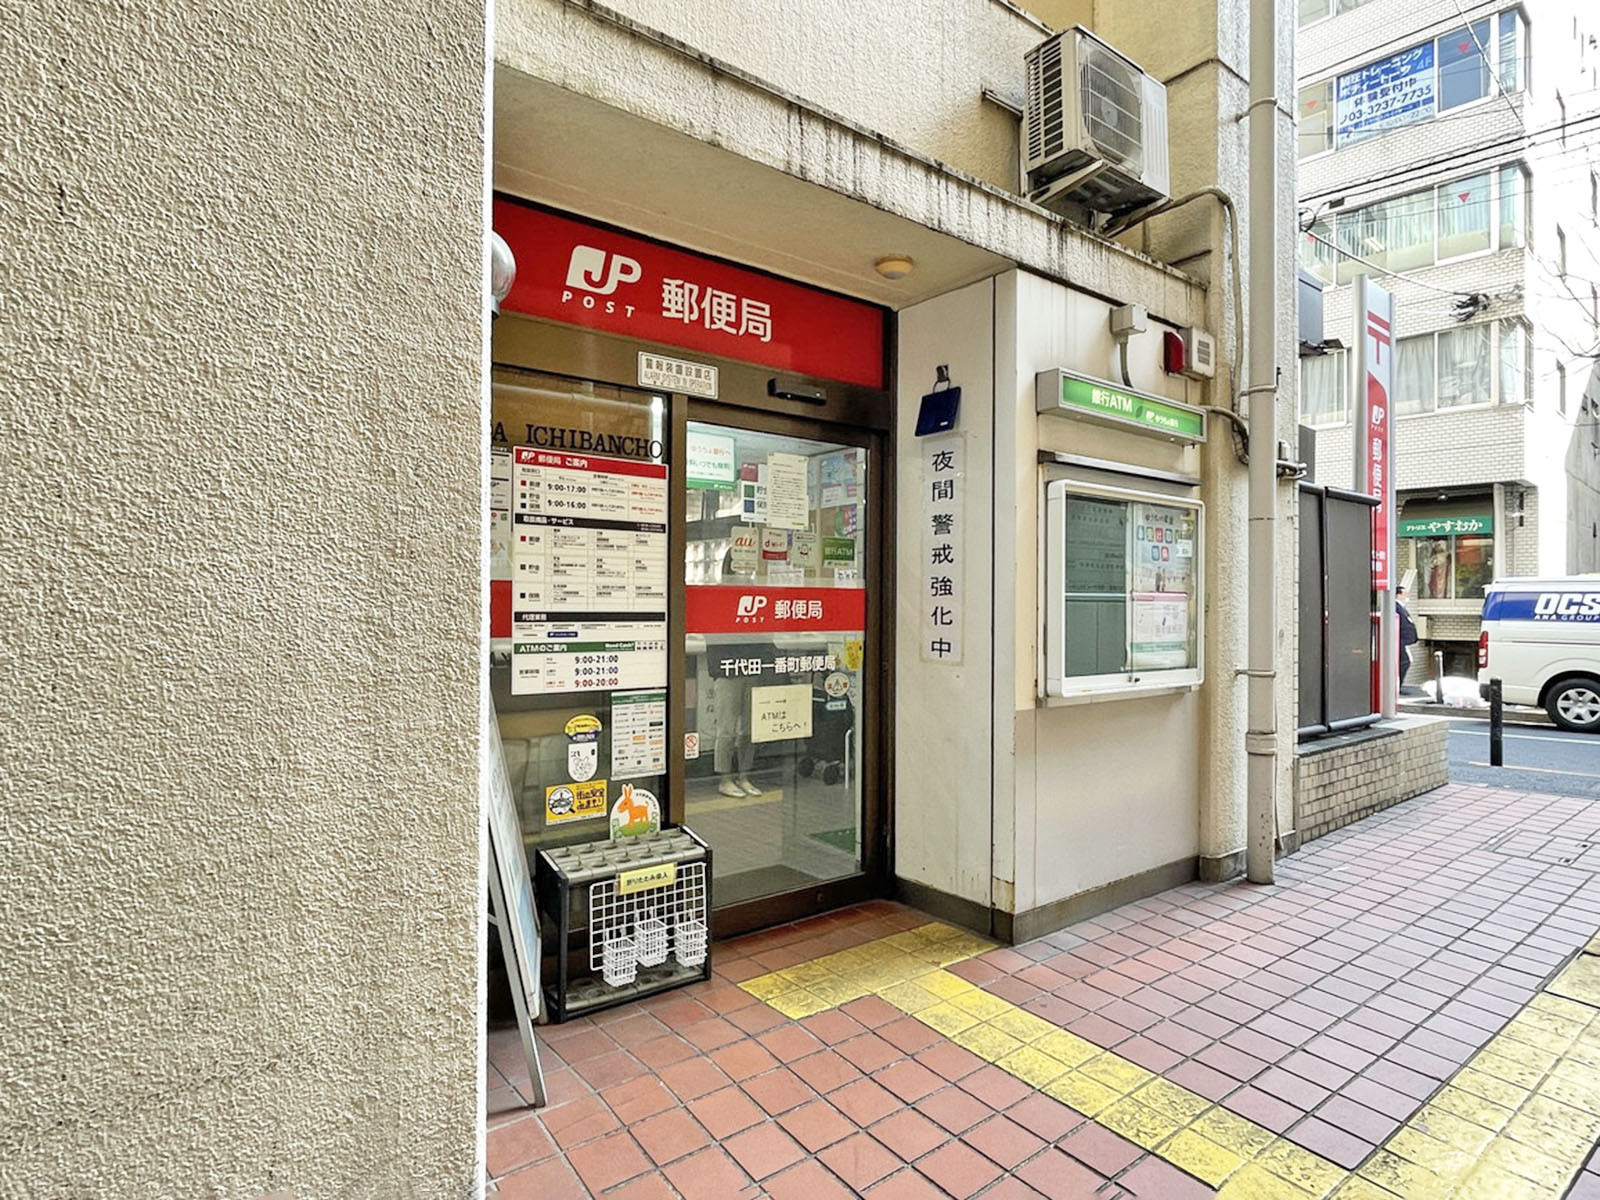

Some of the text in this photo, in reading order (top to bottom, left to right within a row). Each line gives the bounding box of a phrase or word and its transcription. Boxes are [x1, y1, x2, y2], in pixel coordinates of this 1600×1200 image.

[1354, 77, 1417, 108] 体験受付中
[1348, 84, 1432, 122] 03-3237-7735
[565, 245, 642, 295] JP
[562, 290, 636, 318] POST
[661, 277, 772, 342] 郵便局
[1092, 388, 1133, 413] 銀行ATM
[525, 424, 663, 459] ICHIBANCHO
[565, 457, 588, 468] ご案内
[548, 483, 587, 493] 9:00-17:00
[548, 499, 587, 509] 9:00-16:00
[1427, 519, 1483, 533] やすおか
[735, 536, 754, 547] au
[931, 451, 954, 658] 夜間警戒強化中
[737, 596, 767, 615] JP
[774, 600, 823, 620] 郵便局
[1534, 593, 1600, 615] OCS
[519, 644, 568, 653] ATMのご案内
[574, 655, 619, 664] 9:00-21:00
[720, 655, 836, 676] 千代田一番町郵便局
[574, 667, 619, 676] 9:00-21:00
[574, 678, 619, 688] 9:00-20:00
[761, 711, 787, 721] ATMは
